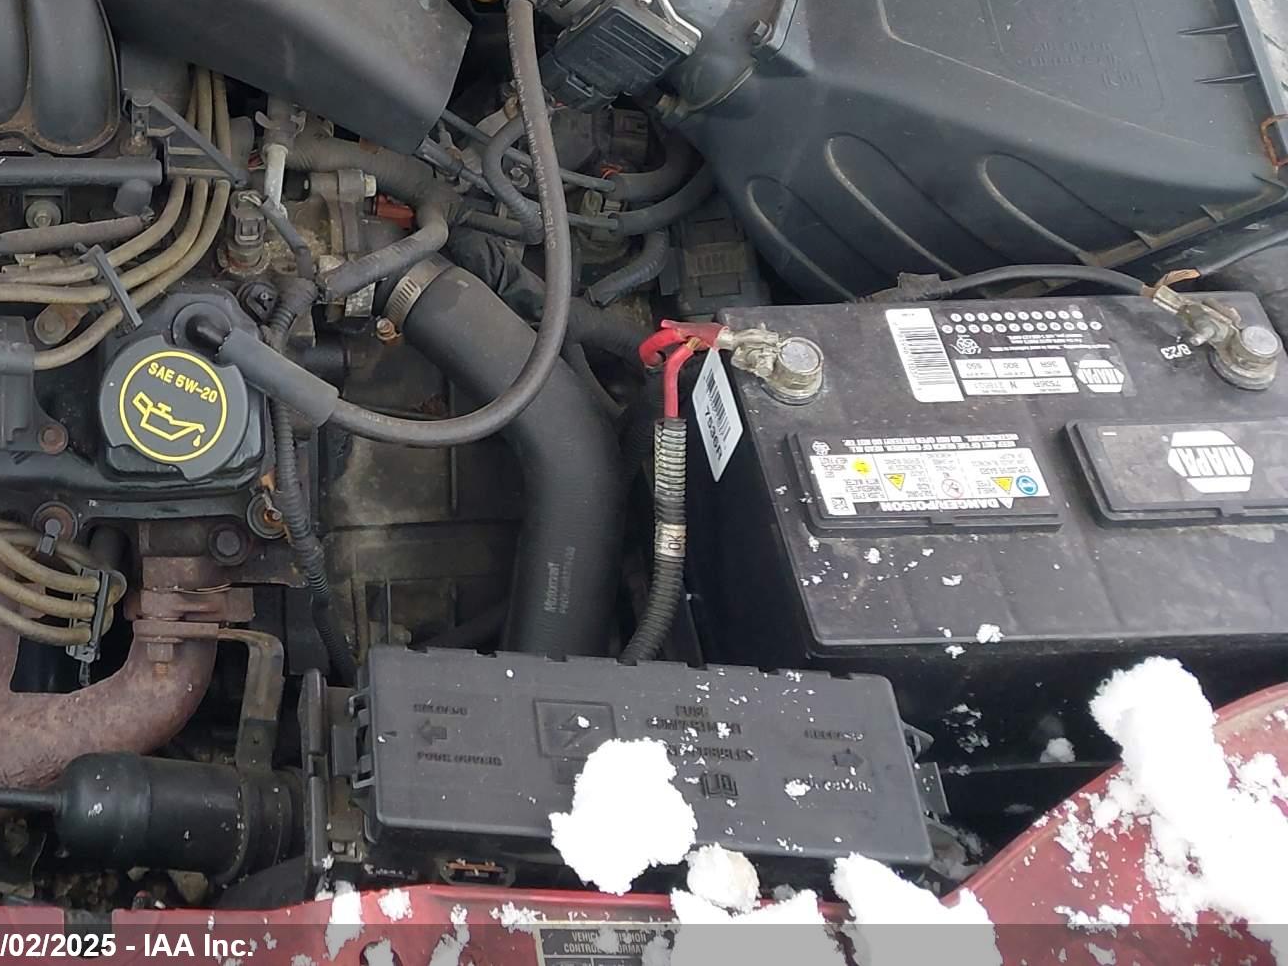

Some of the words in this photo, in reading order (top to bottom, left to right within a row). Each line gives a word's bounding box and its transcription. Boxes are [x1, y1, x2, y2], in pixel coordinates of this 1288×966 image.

[1160, 343, 1192, 359] 8/23
[149, 362, 175, 383] SAE
[175, 375, 217, 403] 5W-20
[1082, 368, 1117, 385] NAPA
[704, 404, 723, 462] 7536R
[1176, 446, 1245, 477] NAPA
